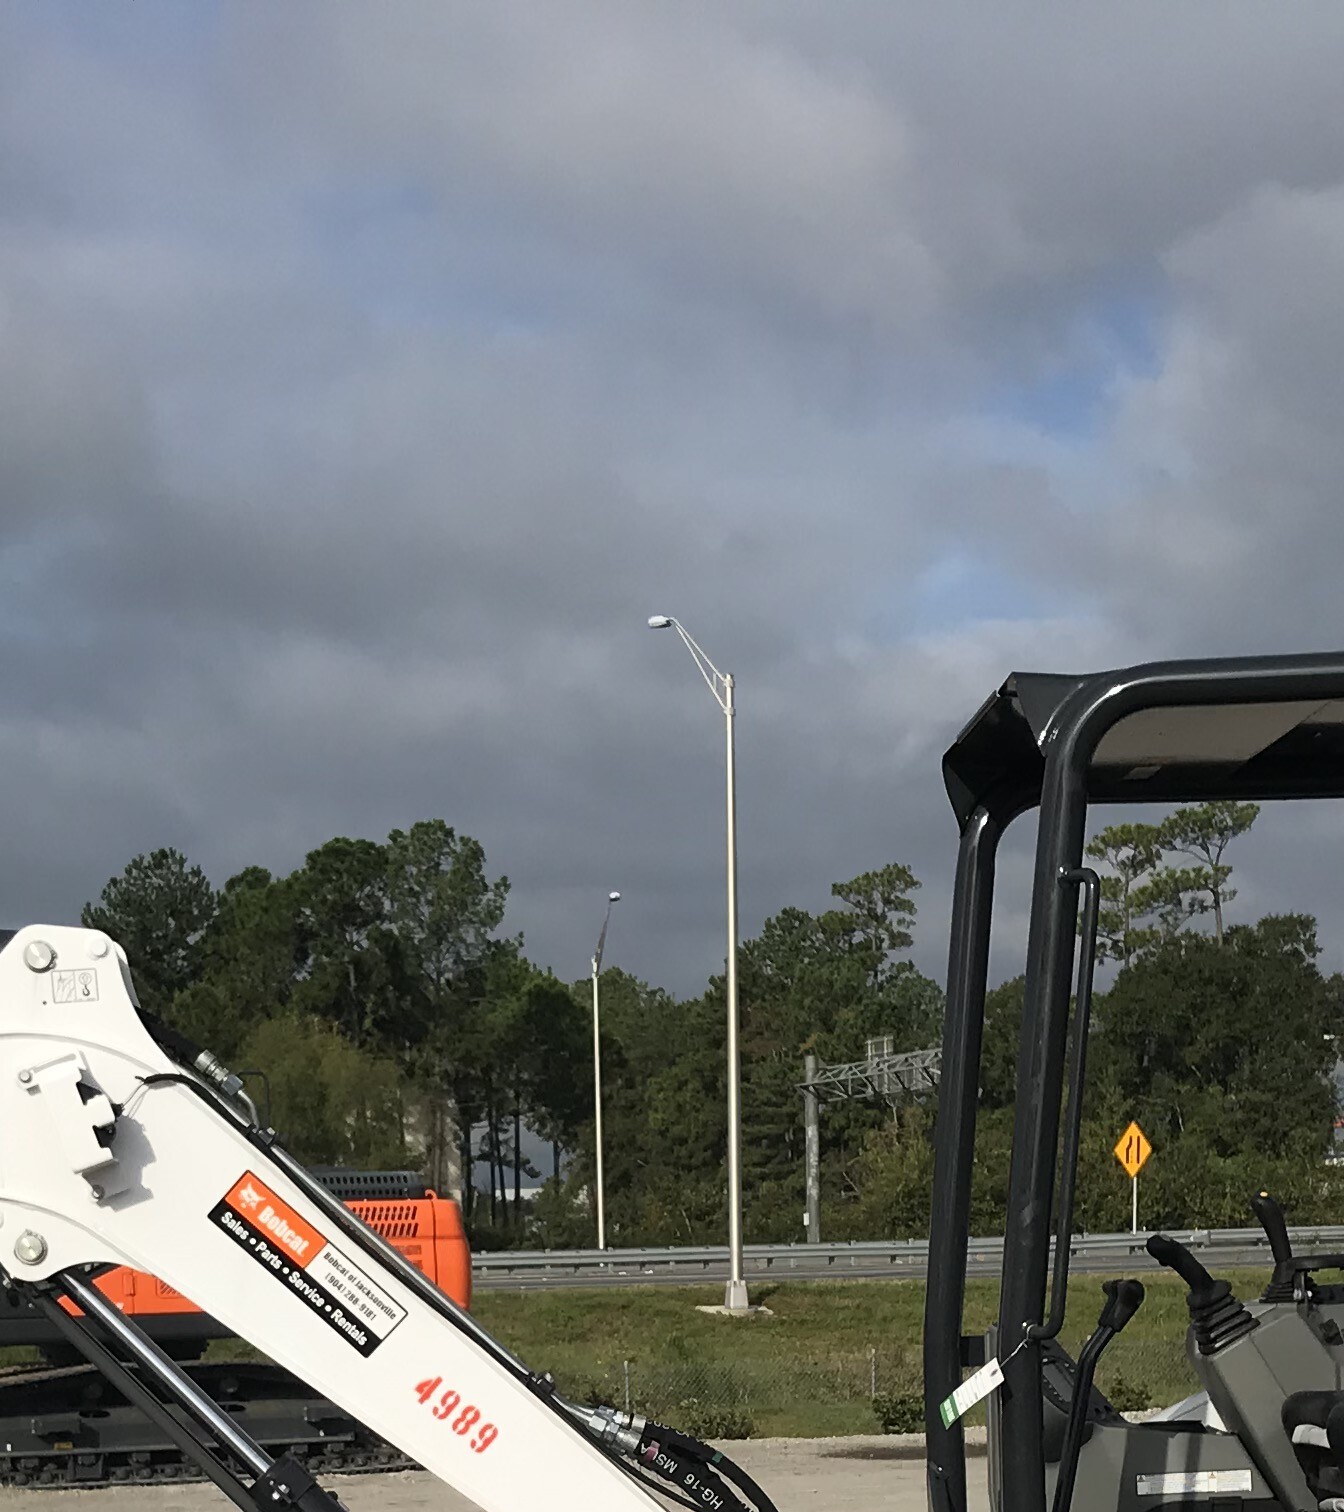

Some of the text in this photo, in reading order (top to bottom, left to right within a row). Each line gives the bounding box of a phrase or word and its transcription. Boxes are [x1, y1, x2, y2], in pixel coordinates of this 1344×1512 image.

[258, 1205, 310, 1257] Bobcat
[221, 1211, 368, 1346] Sales Parts Service Rentals
[323, 1251, 397, 1320] Bobcat of Jacksonville
[414, 1376, 499, 1454] 4989
[683, 1473, 724, 1510] HG-16
